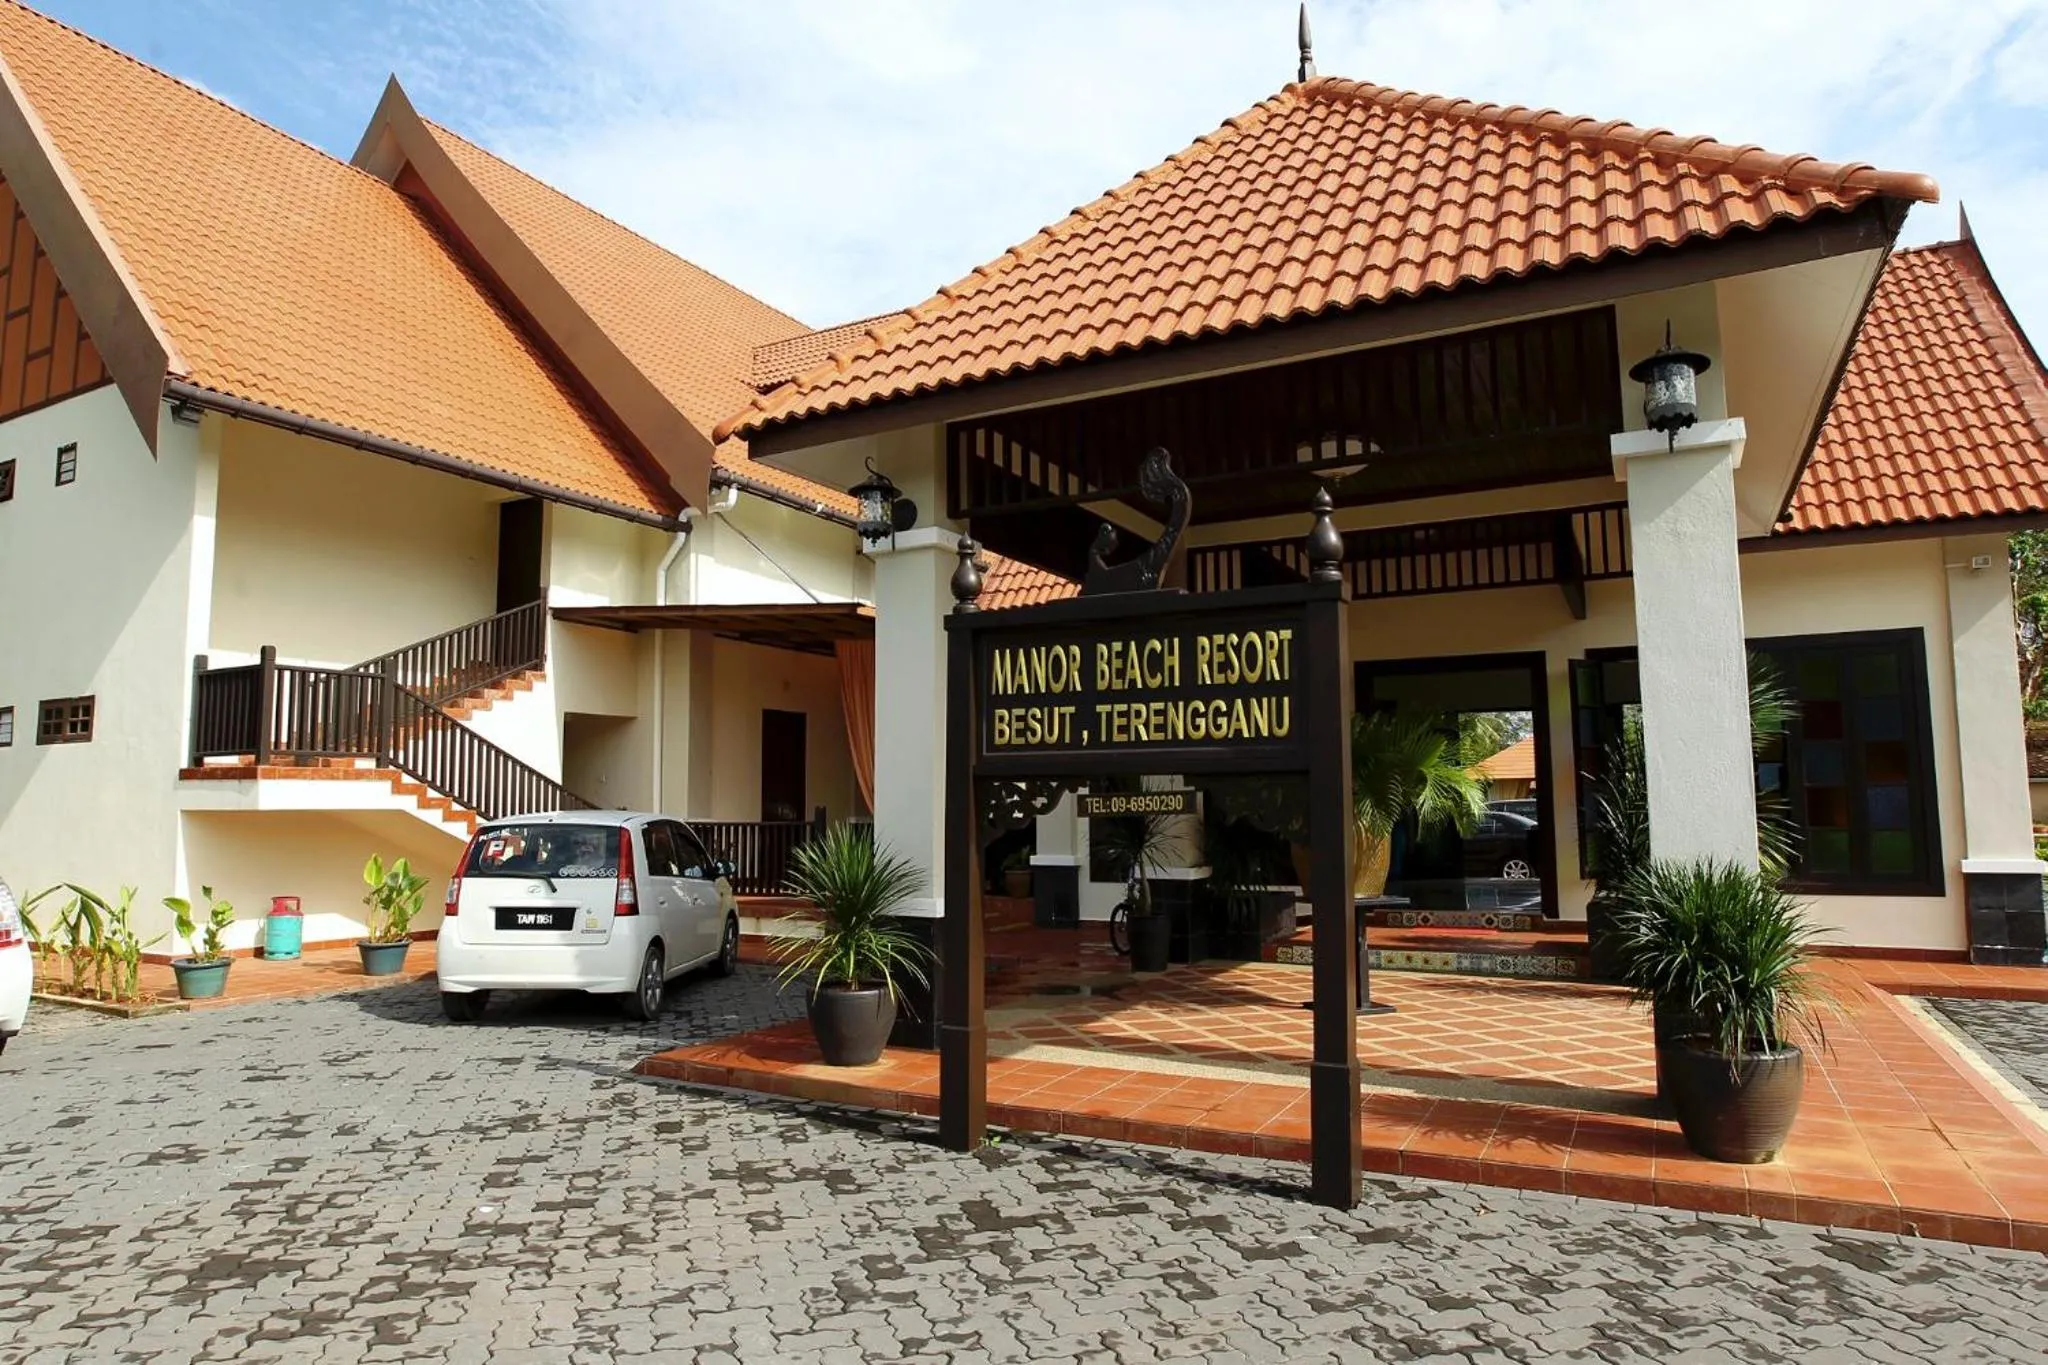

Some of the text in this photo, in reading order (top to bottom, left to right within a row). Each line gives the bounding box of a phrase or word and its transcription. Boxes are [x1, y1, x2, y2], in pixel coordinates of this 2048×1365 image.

[991, 629, 1293, 695] MANOR BEACH RESORT
[1096, 696, 1291, 742] TERENGGANU
